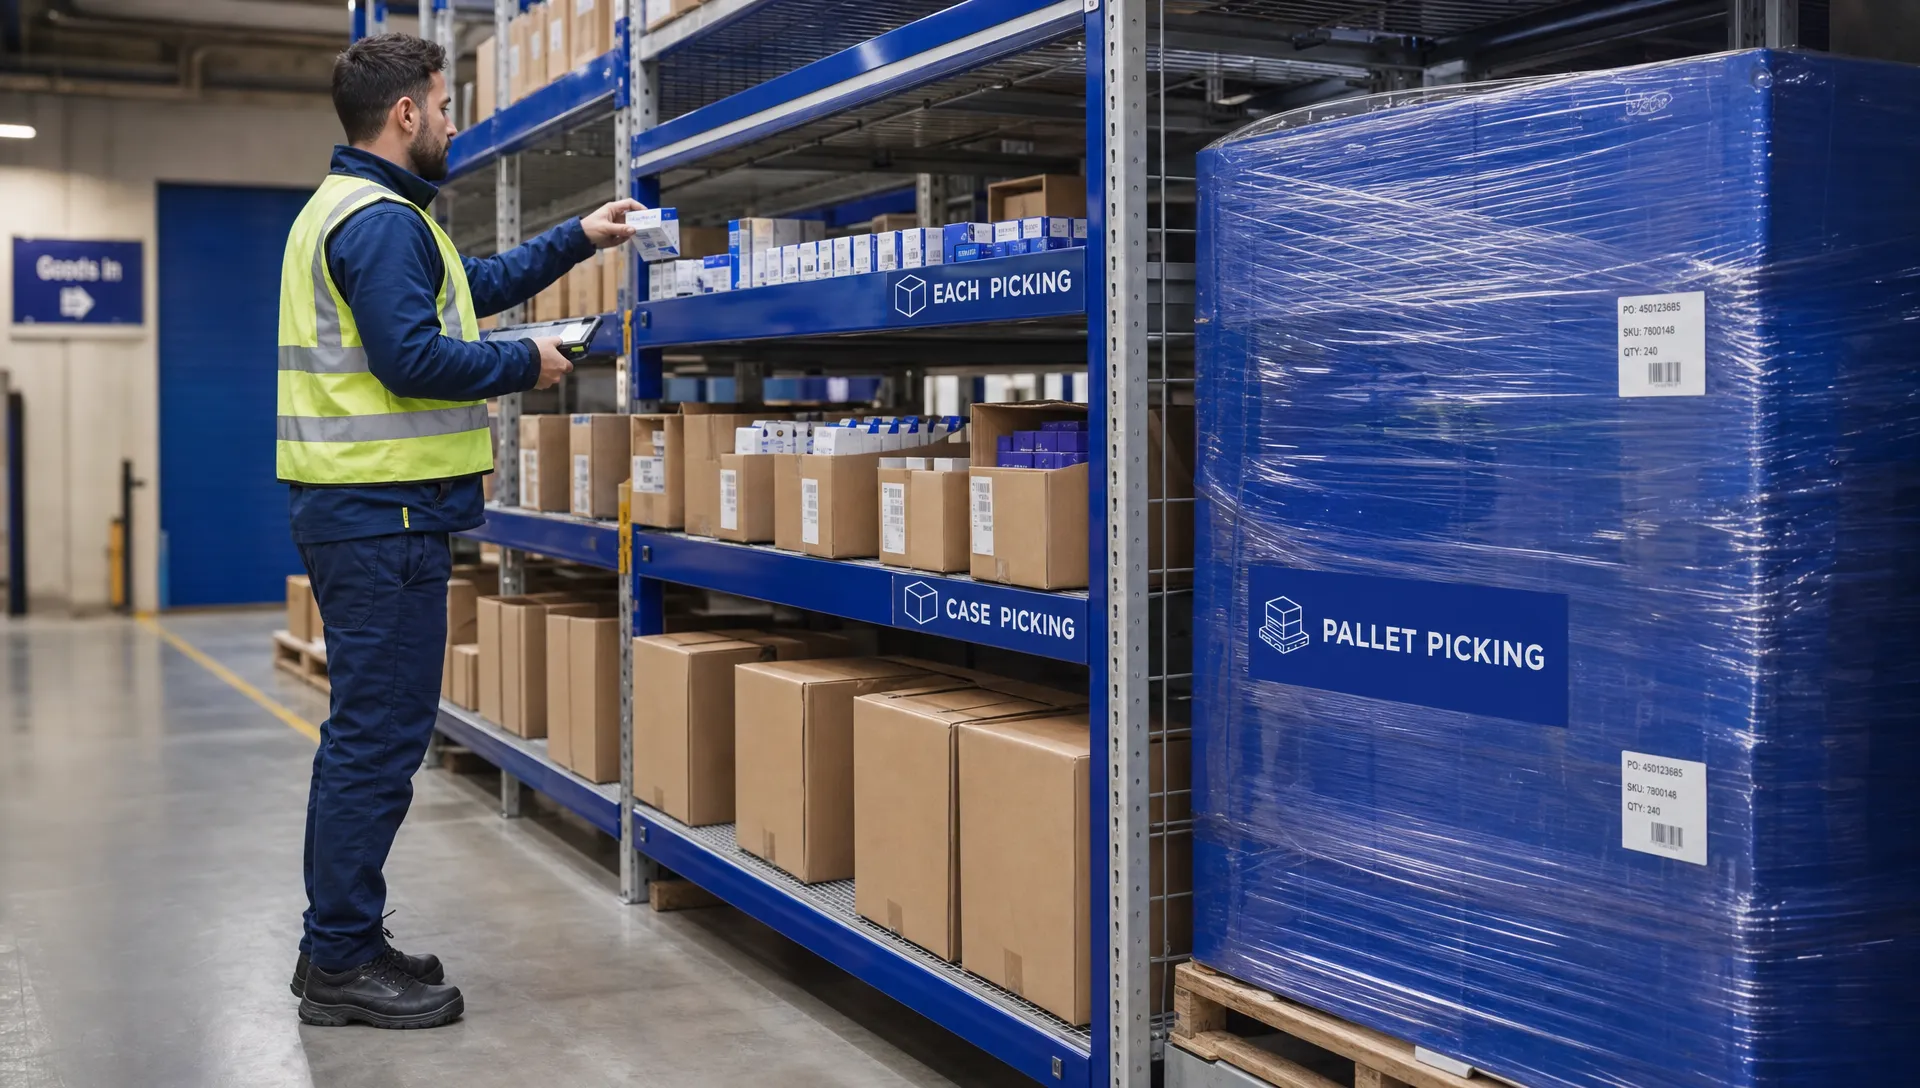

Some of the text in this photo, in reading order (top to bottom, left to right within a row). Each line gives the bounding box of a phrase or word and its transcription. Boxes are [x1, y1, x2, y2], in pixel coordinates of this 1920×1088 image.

[36, 254, 123, 282] Goods in
[933, 269, 1072, 304] EACH PICKING
[1623, 302, 1681, 315] PO: 450123685
[1623, 325, 1675, 338] SKU: 7800148
[1623, 345, 1658, 357] QTY: 240
[946, 597, 1076, 641] CASE PICKING
[1322, 618, 1546, 671] PALLET PICKING
[1627, 759, 1683, 778] PO: 450123685
[1627, 782, 1677, 800] SKU: 7800148
[1627, 801, 1661, 816] QTY: 240
